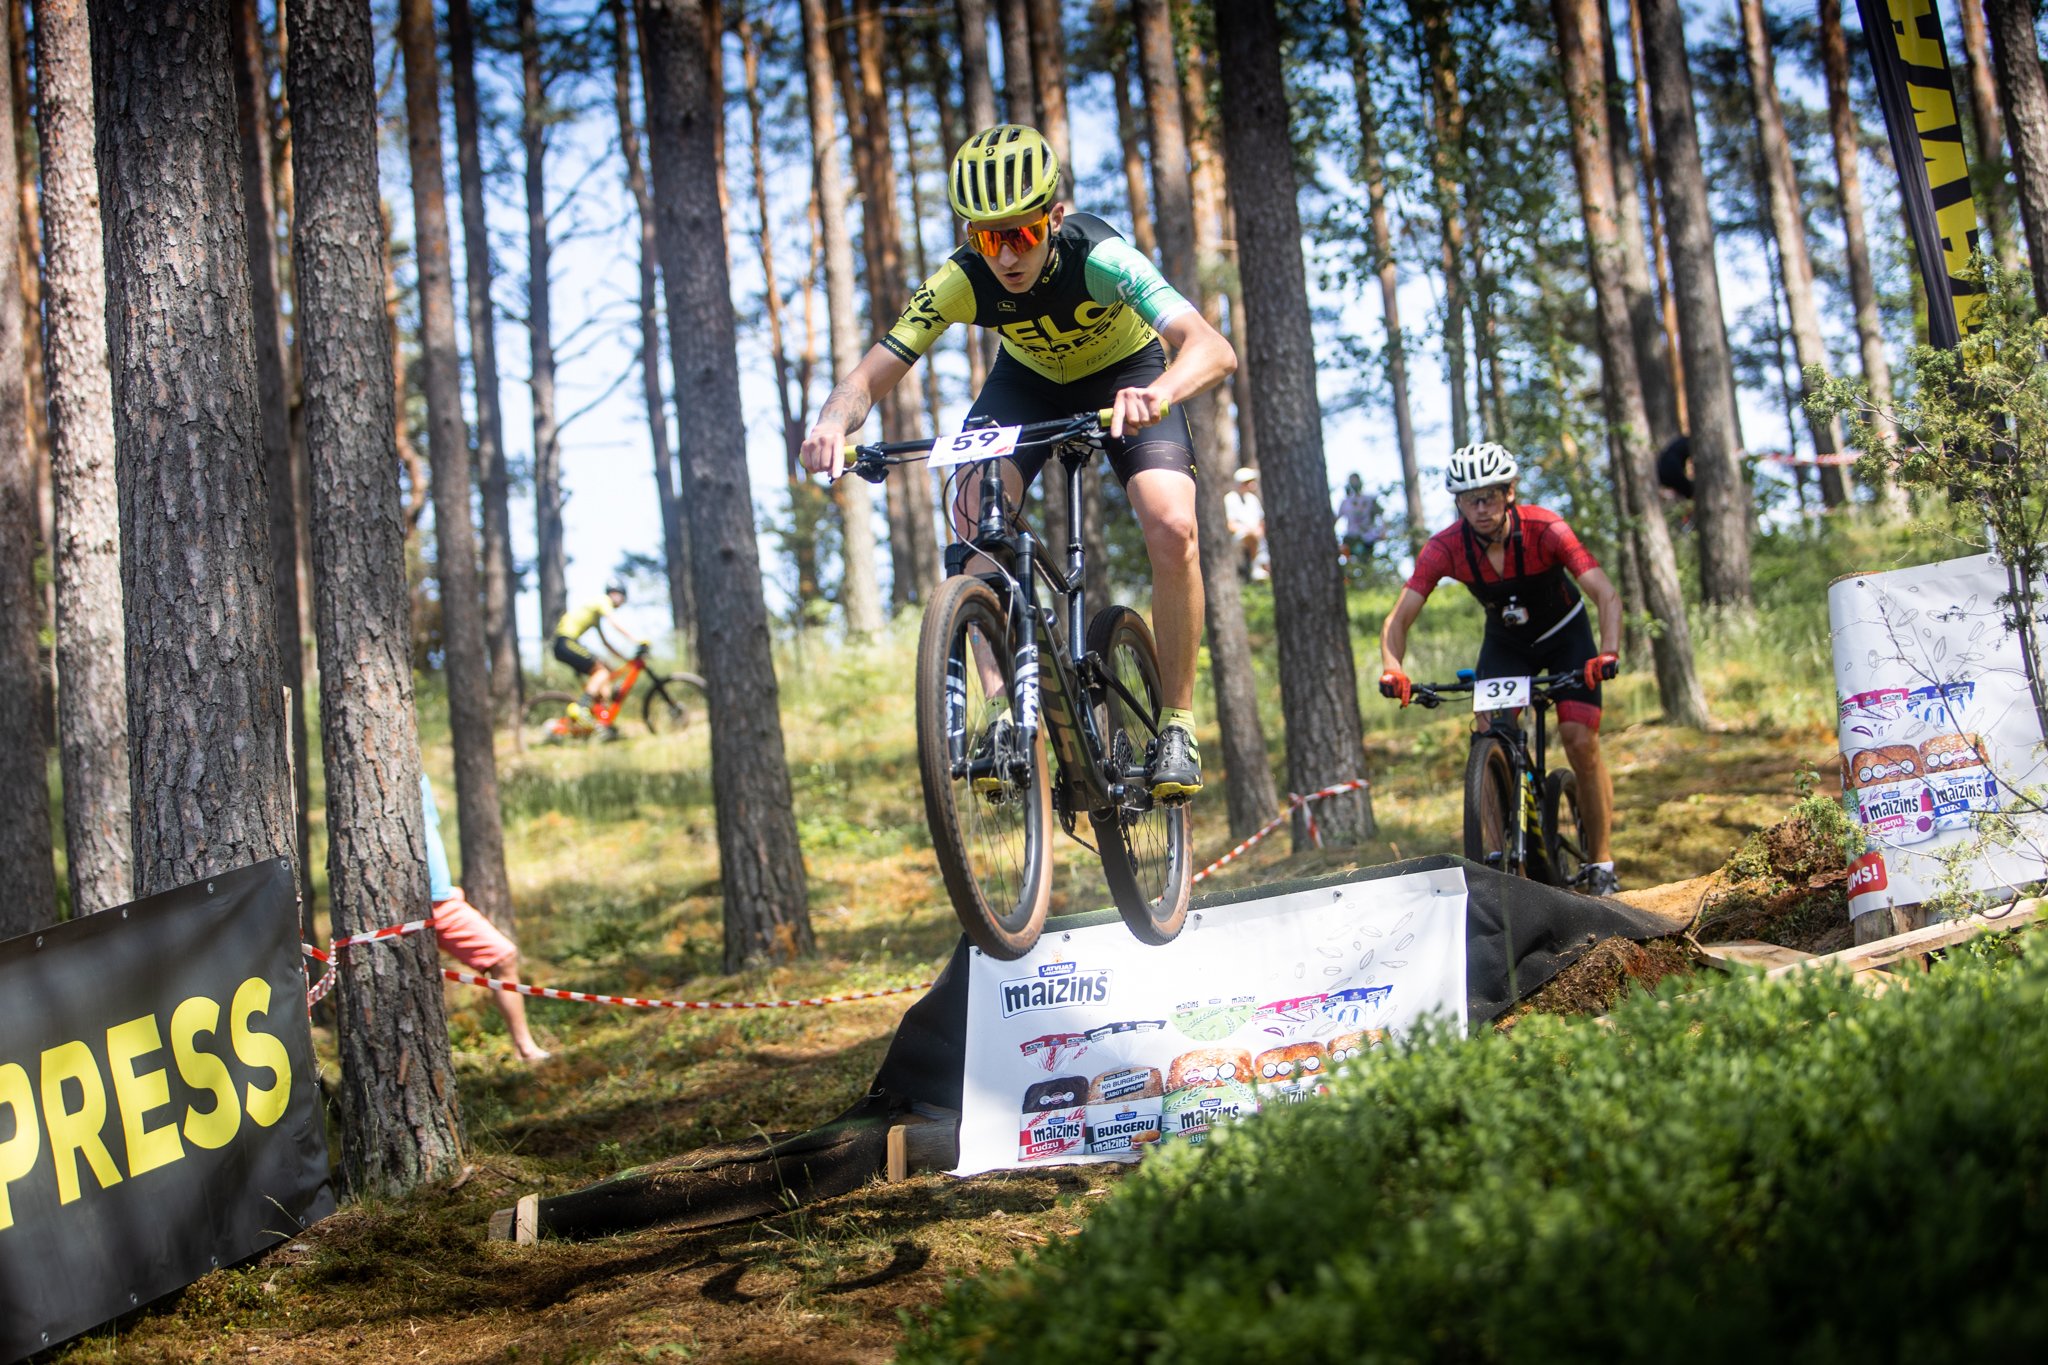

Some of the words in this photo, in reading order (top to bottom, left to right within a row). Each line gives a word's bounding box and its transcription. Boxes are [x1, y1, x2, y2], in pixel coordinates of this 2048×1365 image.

[951, 431, 1000, 451] 59
[1487, 680, 1517, 698] 39
[1868, 795, 1919, 820] maiziņš
[1004, 971, 1108, 1012] maiziņš
[0, 977, 291, 1230] PRESS
[1034, 1121, 1080, 1143] maiziņš
[1098, 1120, 1155, 1138] BURGERU
[1031, 1141, 1059, 1152] rudzu
